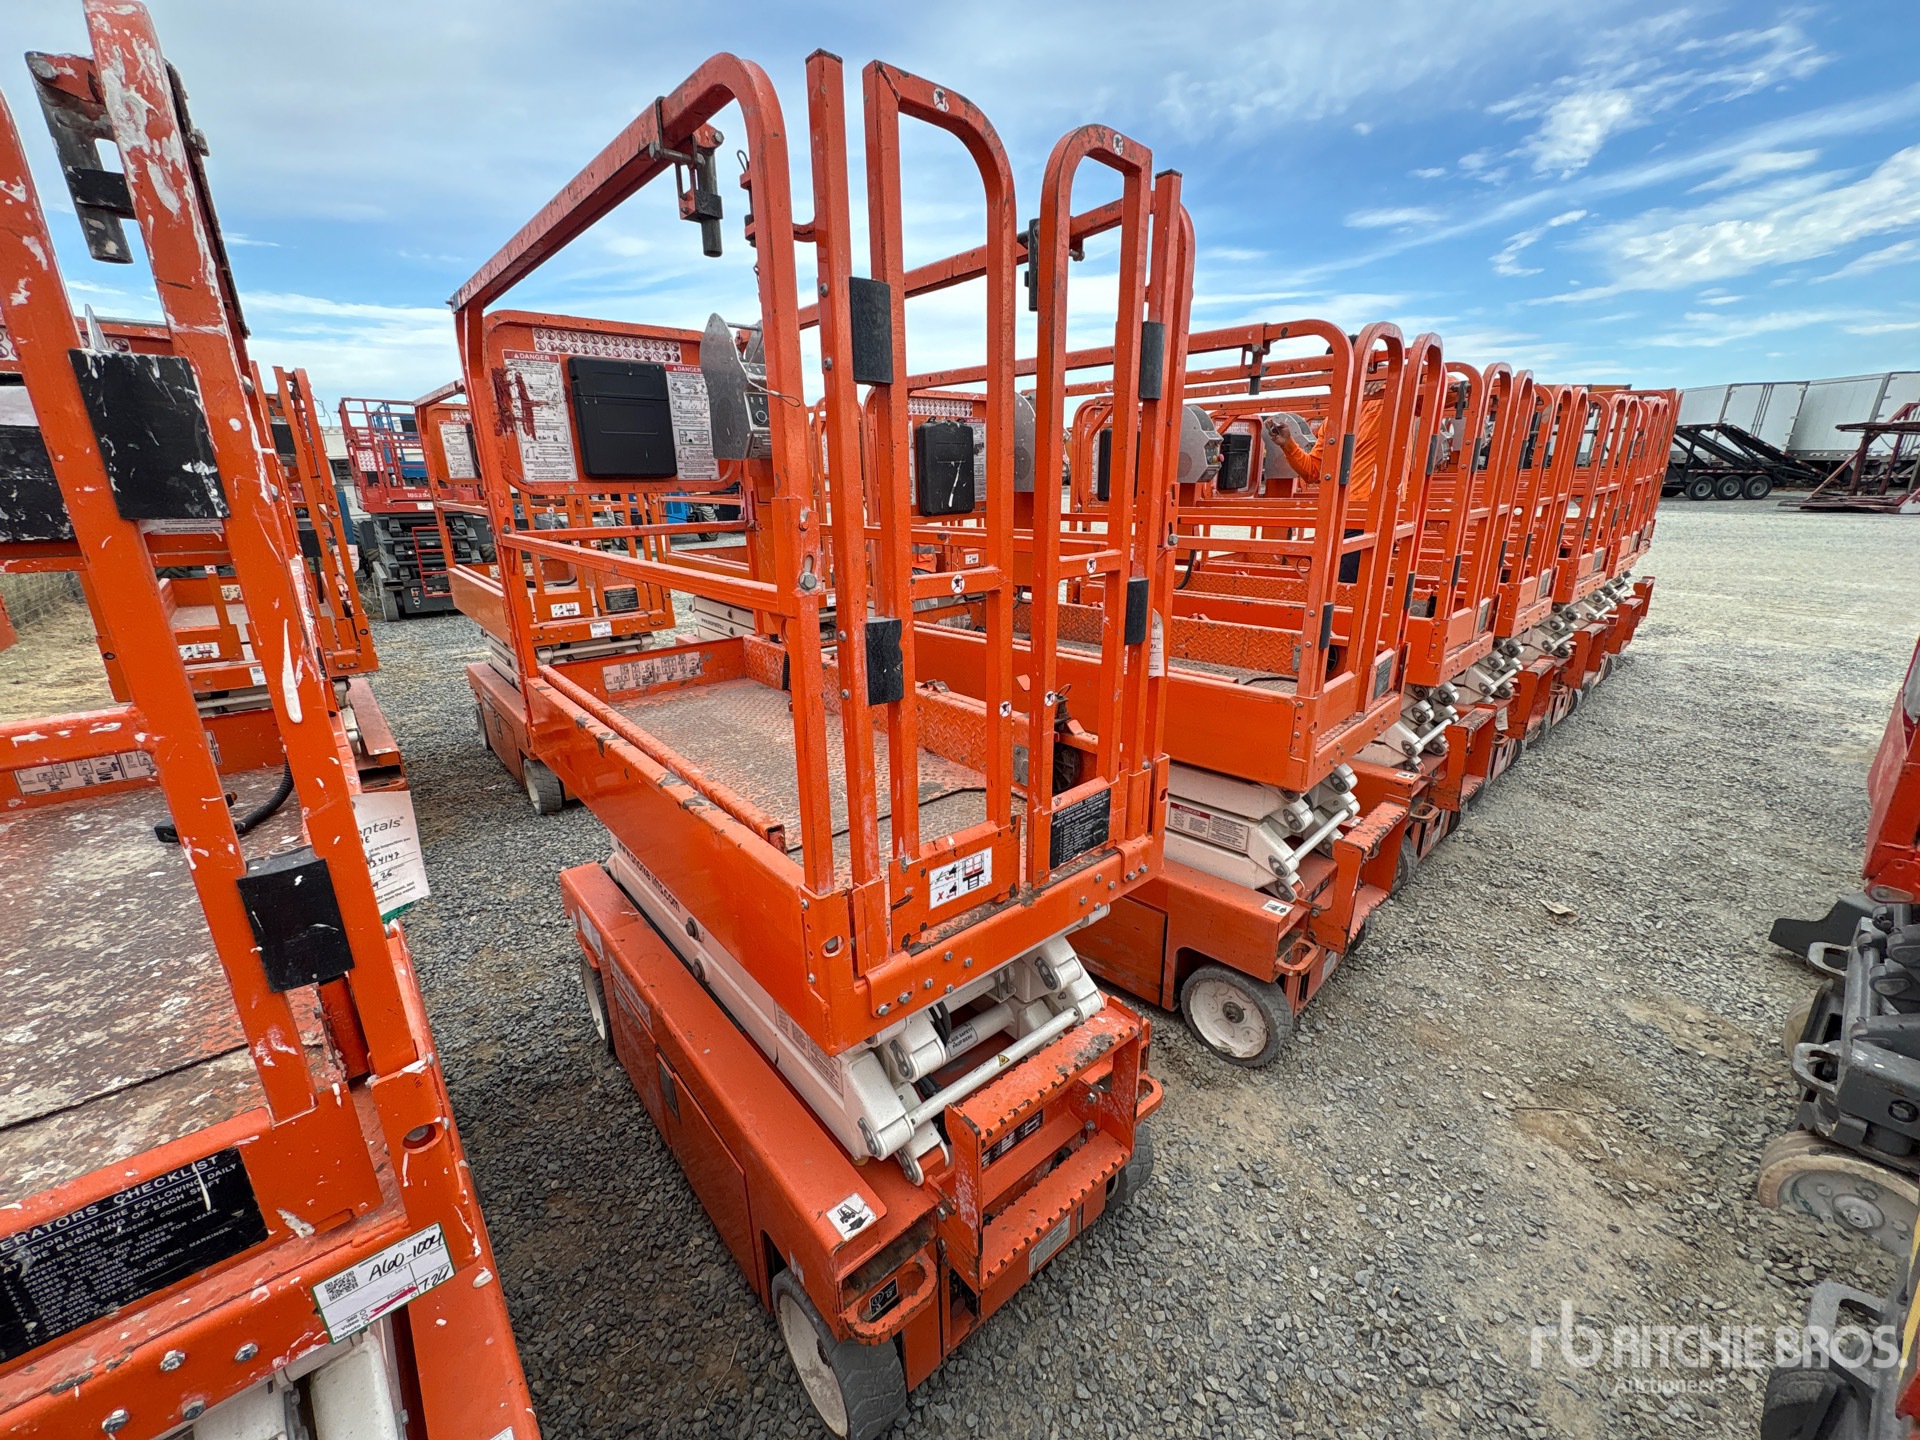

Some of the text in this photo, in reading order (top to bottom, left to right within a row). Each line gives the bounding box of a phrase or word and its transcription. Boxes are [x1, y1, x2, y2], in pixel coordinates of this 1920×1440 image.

[519, 352, 551, 361] DANGER
[67, 1220, 99, 1238] TEST
[103, 1208, 128, 1223] THE
[206, 1162, 237, 1180] DAILY
[112, 1155, 219, 1205] CHECKLIST
[55, 1217, 125, 1252] BEGINNING
[130, 1208, 148, 1220] OF
[152, 1193, 184, 1210] EACH
[170, 1221, 187, 1231] FOR
